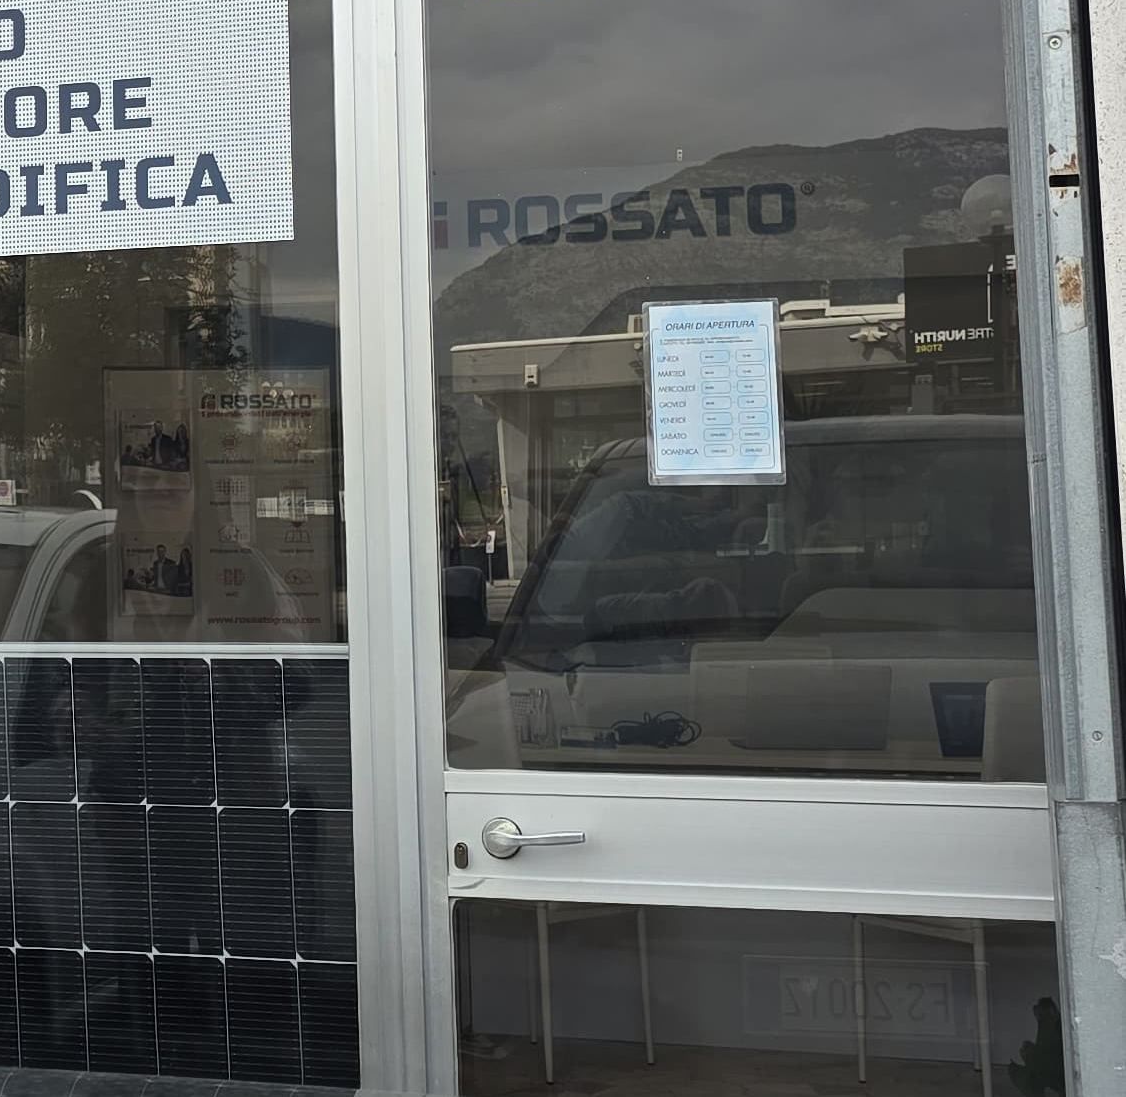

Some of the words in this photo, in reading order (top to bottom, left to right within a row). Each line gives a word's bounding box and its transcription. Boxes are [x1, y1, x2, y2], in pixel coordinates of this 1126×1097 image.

[467, 182, 797, 248] ROSSATO
[665, 322, 693, 332] ORARI
[705, 320, 755, 329] APERTURA
